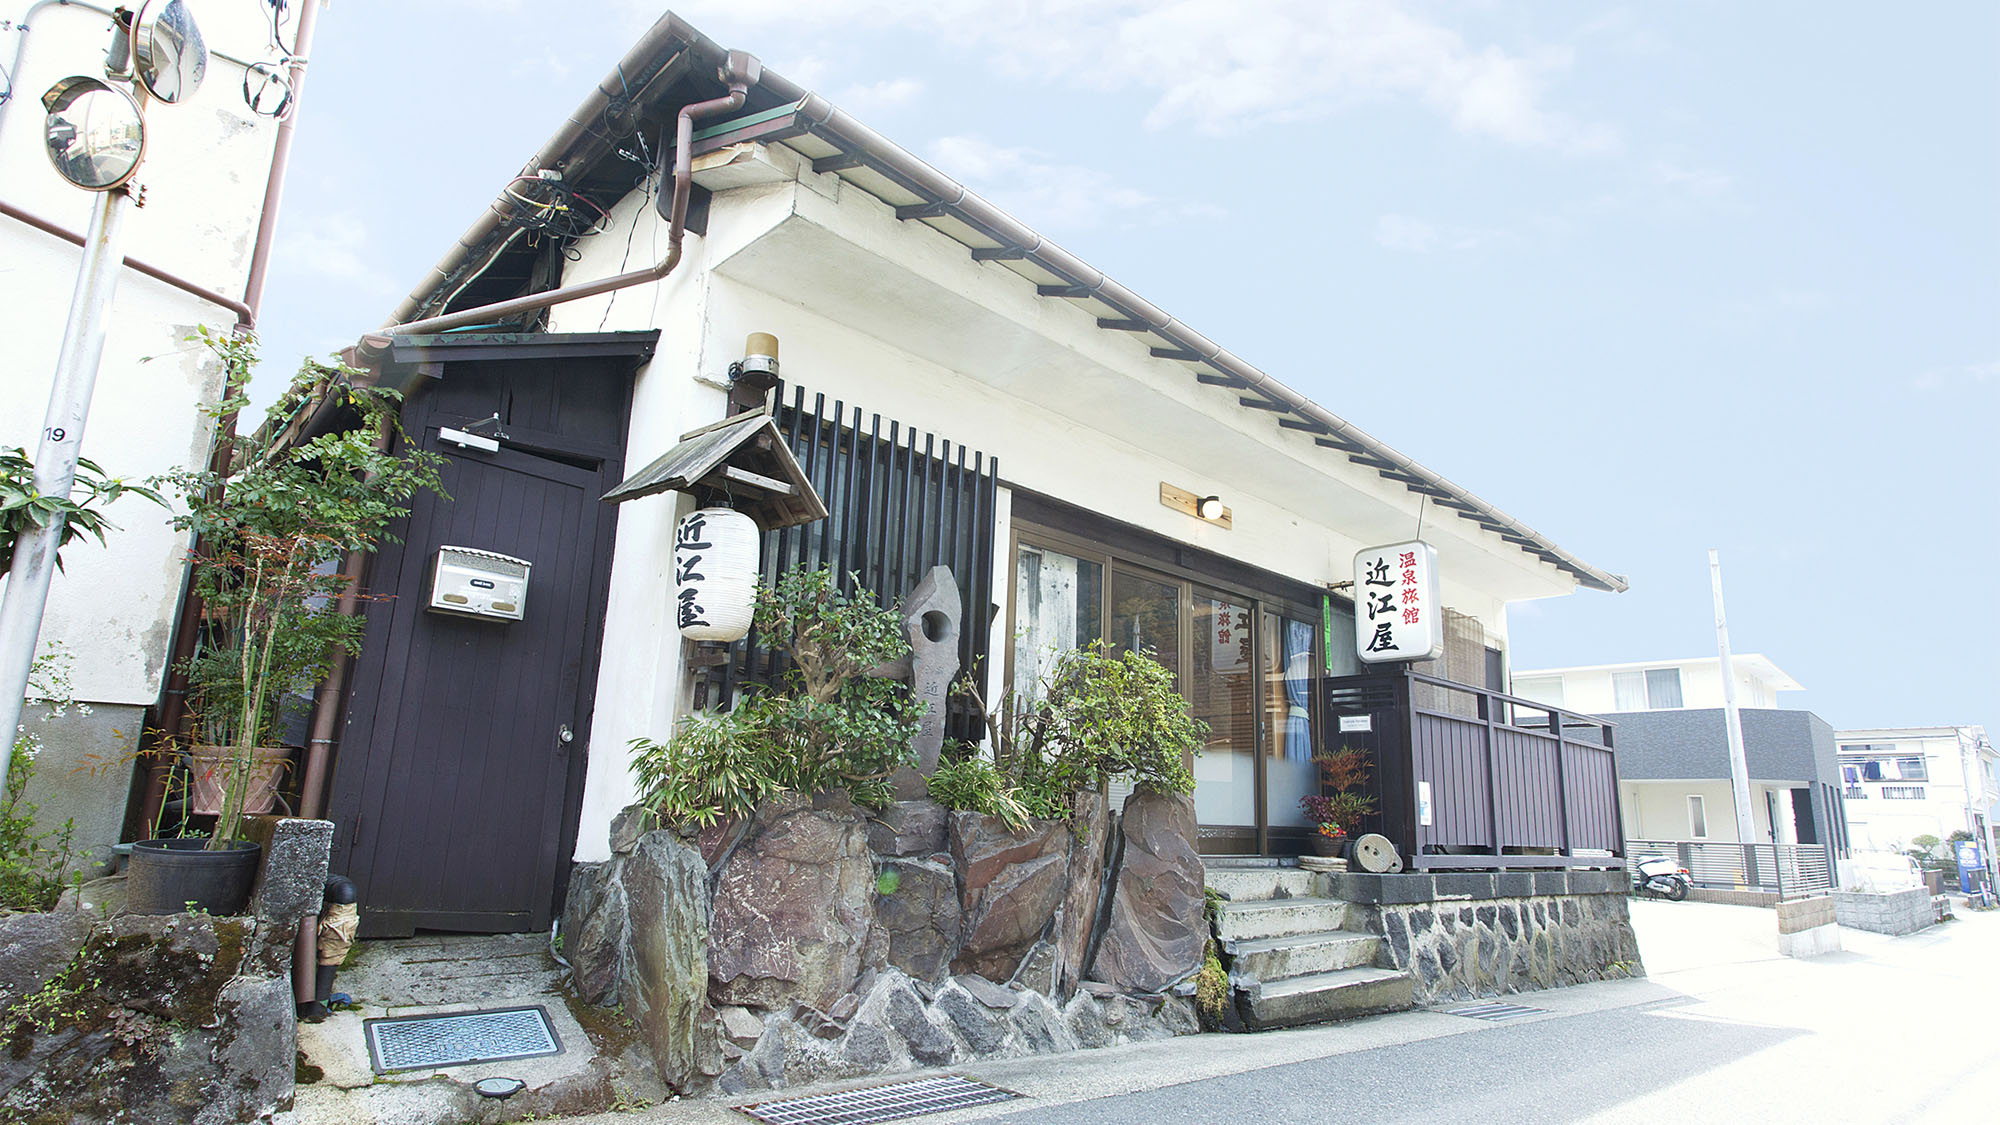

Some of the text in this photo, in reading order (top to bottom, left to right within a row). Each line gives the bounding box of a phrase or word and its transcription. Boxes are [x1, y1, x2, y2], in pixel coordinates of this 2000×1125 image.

[45, 427, 66, 442] 19
[674, 512, 713, 630] 近江屋
[1365, 556, 1400, 653] 近江屋
[1399, 551, 1420, 625] 温泉旅館
